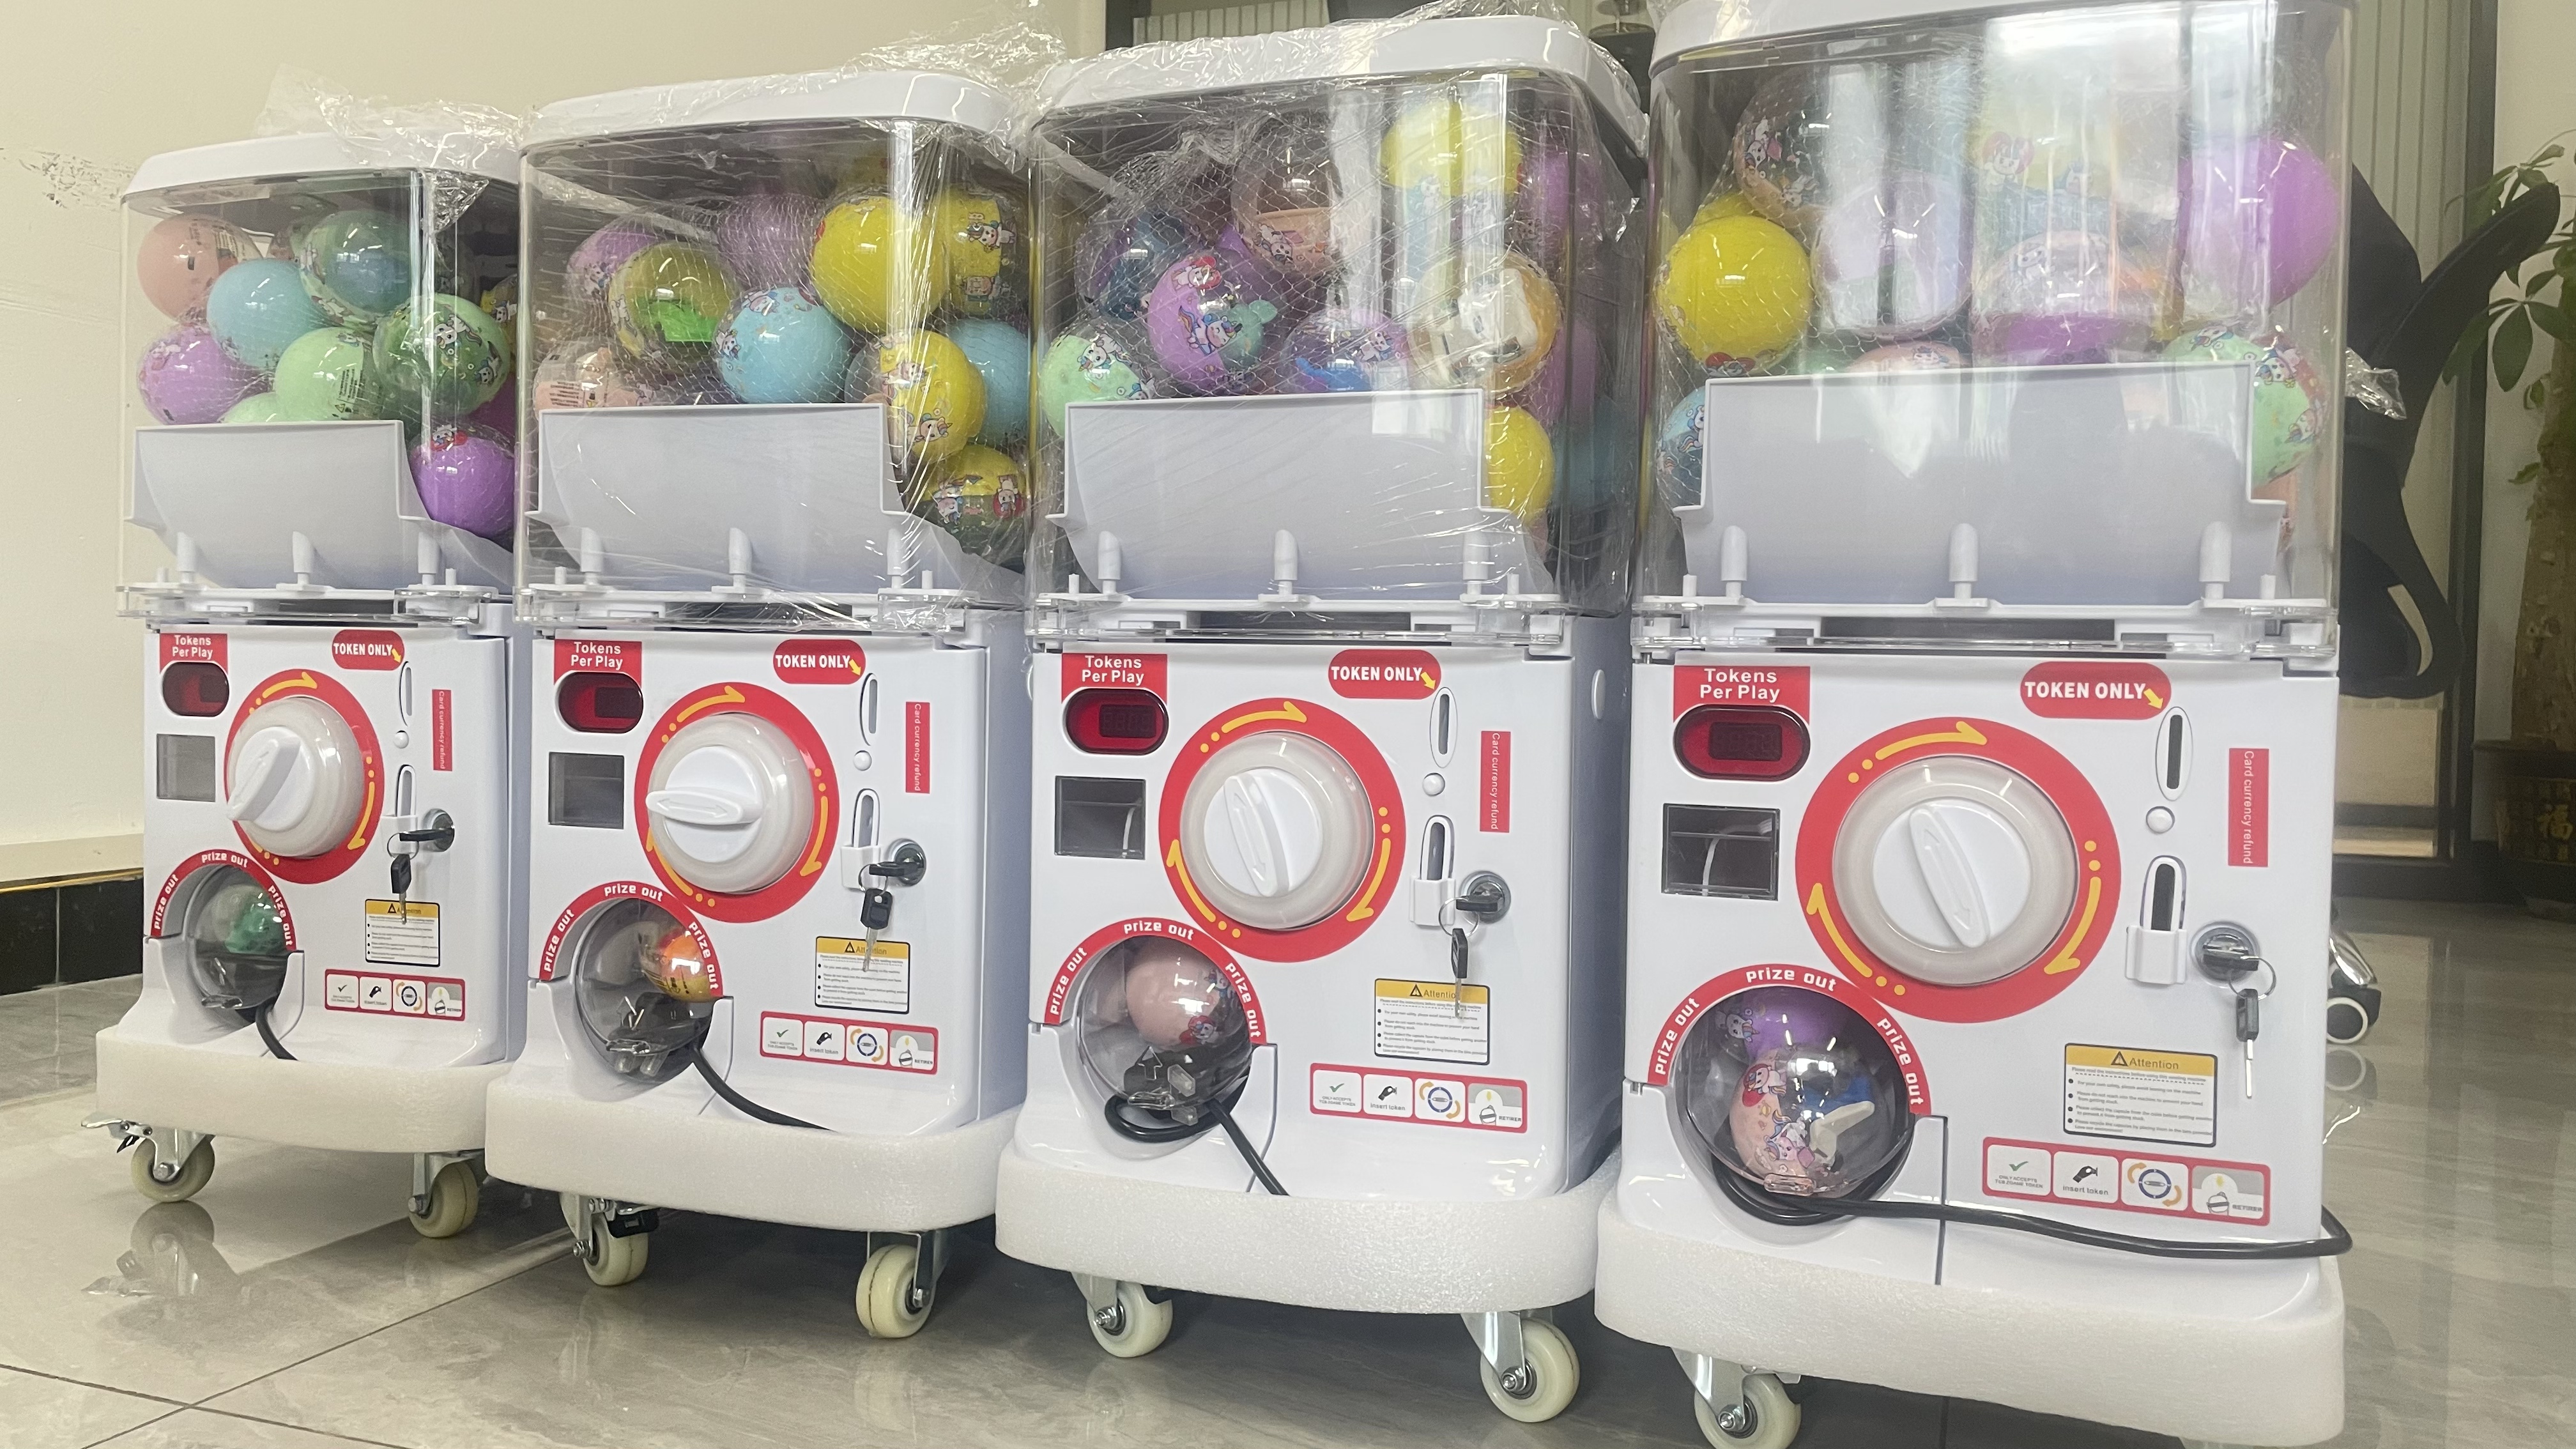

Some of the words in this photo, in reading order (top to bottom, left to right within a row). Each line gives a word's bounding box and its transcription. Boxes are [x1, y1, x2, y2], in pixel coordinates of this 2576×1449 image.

[174, 634, 211, 646] Tokens
[333, 643, 365, 656] TOKEN
[367, 643, 393, 656] ONLY
[574, 641, 621, 655] Tokens
[172, 646, 190, 657] Per
[191, 647, 213, 660] Play
[571, 654, 592, 667] Per
[594, 655, 623, 671] Play
[775, 654, 816, 668] TOKEN
[818, 655, 851, 668] ONLY
[1085, 655, 1142, 669] Tokens
[1082, 669, 1108, 682] Per
[1111, 670, 1144, 686] Play
[1331, 666, 1380, 680] TOKEN
[1384, 666, 1422, 682] ONLY
[1704, 668, 1777, 683] Tokens
[1700, 684, 1733, 699] Per
[1738, 684, 1780, 702] Play
[2025, 681, 2089, 698] TOKEN
[2095, 682, 2145, 700] ONLY
[1492, 733, 1500, 755] Card
[2244, 751, 2254, 777] Card
[1489, 757, 1498, 798] currency
[2241, 779, 2252, 827] currency
[1491, 800, 1499, 830] refund
[2243, 829, 2254, 864] refund
[201, 852, 227, 863] prize
[231, 855, 248, 868] out
[154, 896, 167, 930] prize
[165, 874, 179, 894] out
[604, 884, 636, 897] prize
[641, 887, 664, 902] out
[268, 885, 287, 919] prize
[283, 923, 293, 946] out
[544, 935, 560, 972] prize
[557, 908, 574, 932] out
[1124, 921, 1162, 934] prize
[1169, 924, 1195, 940] out
[688, 921, 711, 959] prize
[707, 964, 719, 990] out
[1050, 975, 1070, 1016] prize
[1067, 947, 1087, 972] out
[1745, 967, 1795, 983] prize
[1804, 972, 1837, 992] out
[1225, 962, 1252, 1003] prize
[1246, 1009, 1261, 1038] out
[1423, 990, 1456, 999] Attentio
[1655, 1029, 1678, 1075] prize
[1675, 997, 1700, 1024] out
[1876, 1018, 1912, 1066] prize
[1905, 1072, 1924, 1105] out
[2129, 1057, 2179, 1070] Attention
[2062, 1185, 2085, 1193] insert
[2087, 1187, 2109, 1195] token
